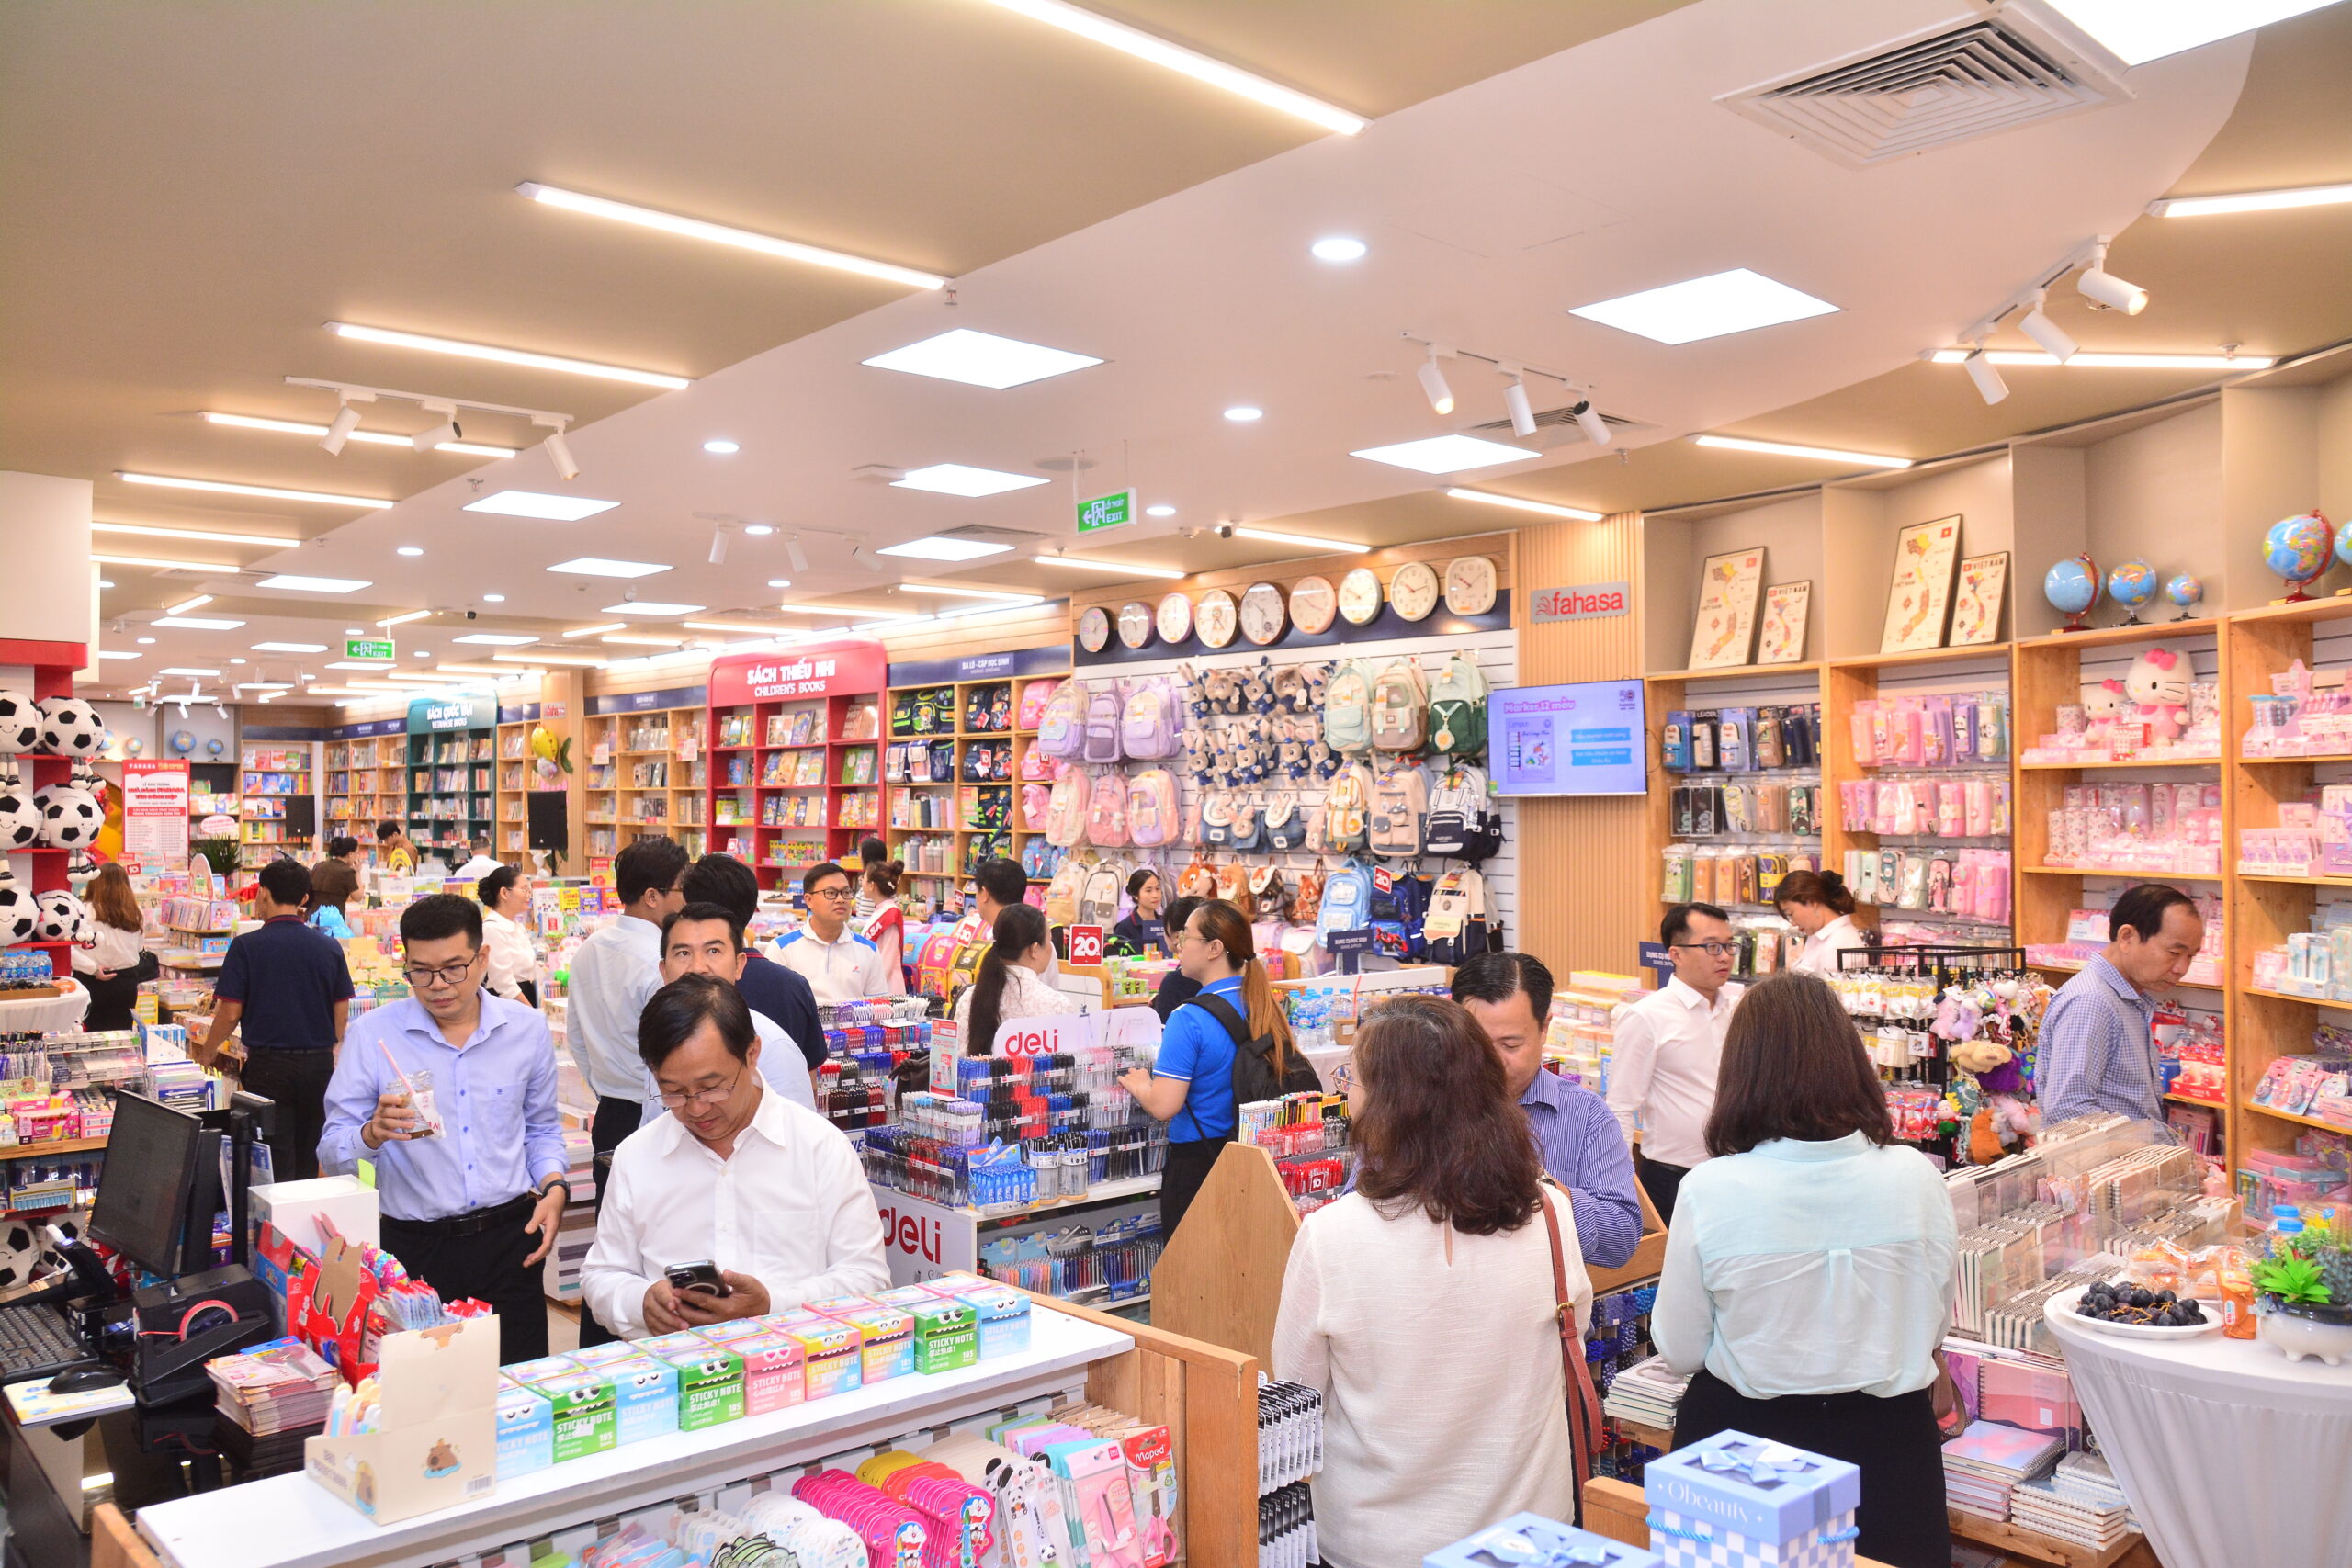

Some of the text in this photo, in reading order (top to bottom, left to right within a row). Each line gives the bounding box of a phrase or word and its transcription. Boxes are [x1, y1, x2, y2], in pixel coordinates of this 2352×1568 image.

[1106, 512, 1123, 523] EXIT
[1553, 591, 1623, 616] fahasa
[747, 656, 836, 685] SÁCH THIẾU NHI
[754, 680, 826, 697] CHILDREN'S BOOKS
[427, 705, 443, 721] SÁCH
[1504, 696, 1576, 714] Marker 12 màu
[453, 718, 468, 728] BOOKS
[1376, 873, 1390, 886] 20
[1005, 1029, 1058, 1056] deli
[1313, 1178, 1321, 1189] 10
[878, 1207, 941, 1264] deli
[866, 1339, 911, 1359] STICKY NOTE
[928, 1335, 955, 1350] STICKY
[955, 1332, 974, 1345] NOTE
[901, 1359, 911, 1367] 105
[963, 1350, 973, 1359] 105
[812, 1360, 839, 1375] STICKY
[840, 1355, 858, 1368] NOTE
[753, 1374, 781, 1390] STICKY
[782, 1370, 802, 1382] NOTE
[847, 1374, 858, 1382] 105
[690, 1388, 718, 1404] STICKY
[720, 1382, 741, 1395] NOTE
[729, 1403, 741, 1412] 105
[556, 1417, 588, 1434] STICKY
[590, 1411, 613, 1426] NOTE
[497, 1438, 525, 1452] TICKY
[599, 1432, 613, 1442] 105
[1135, 1444, 1166, 1464] Maped
